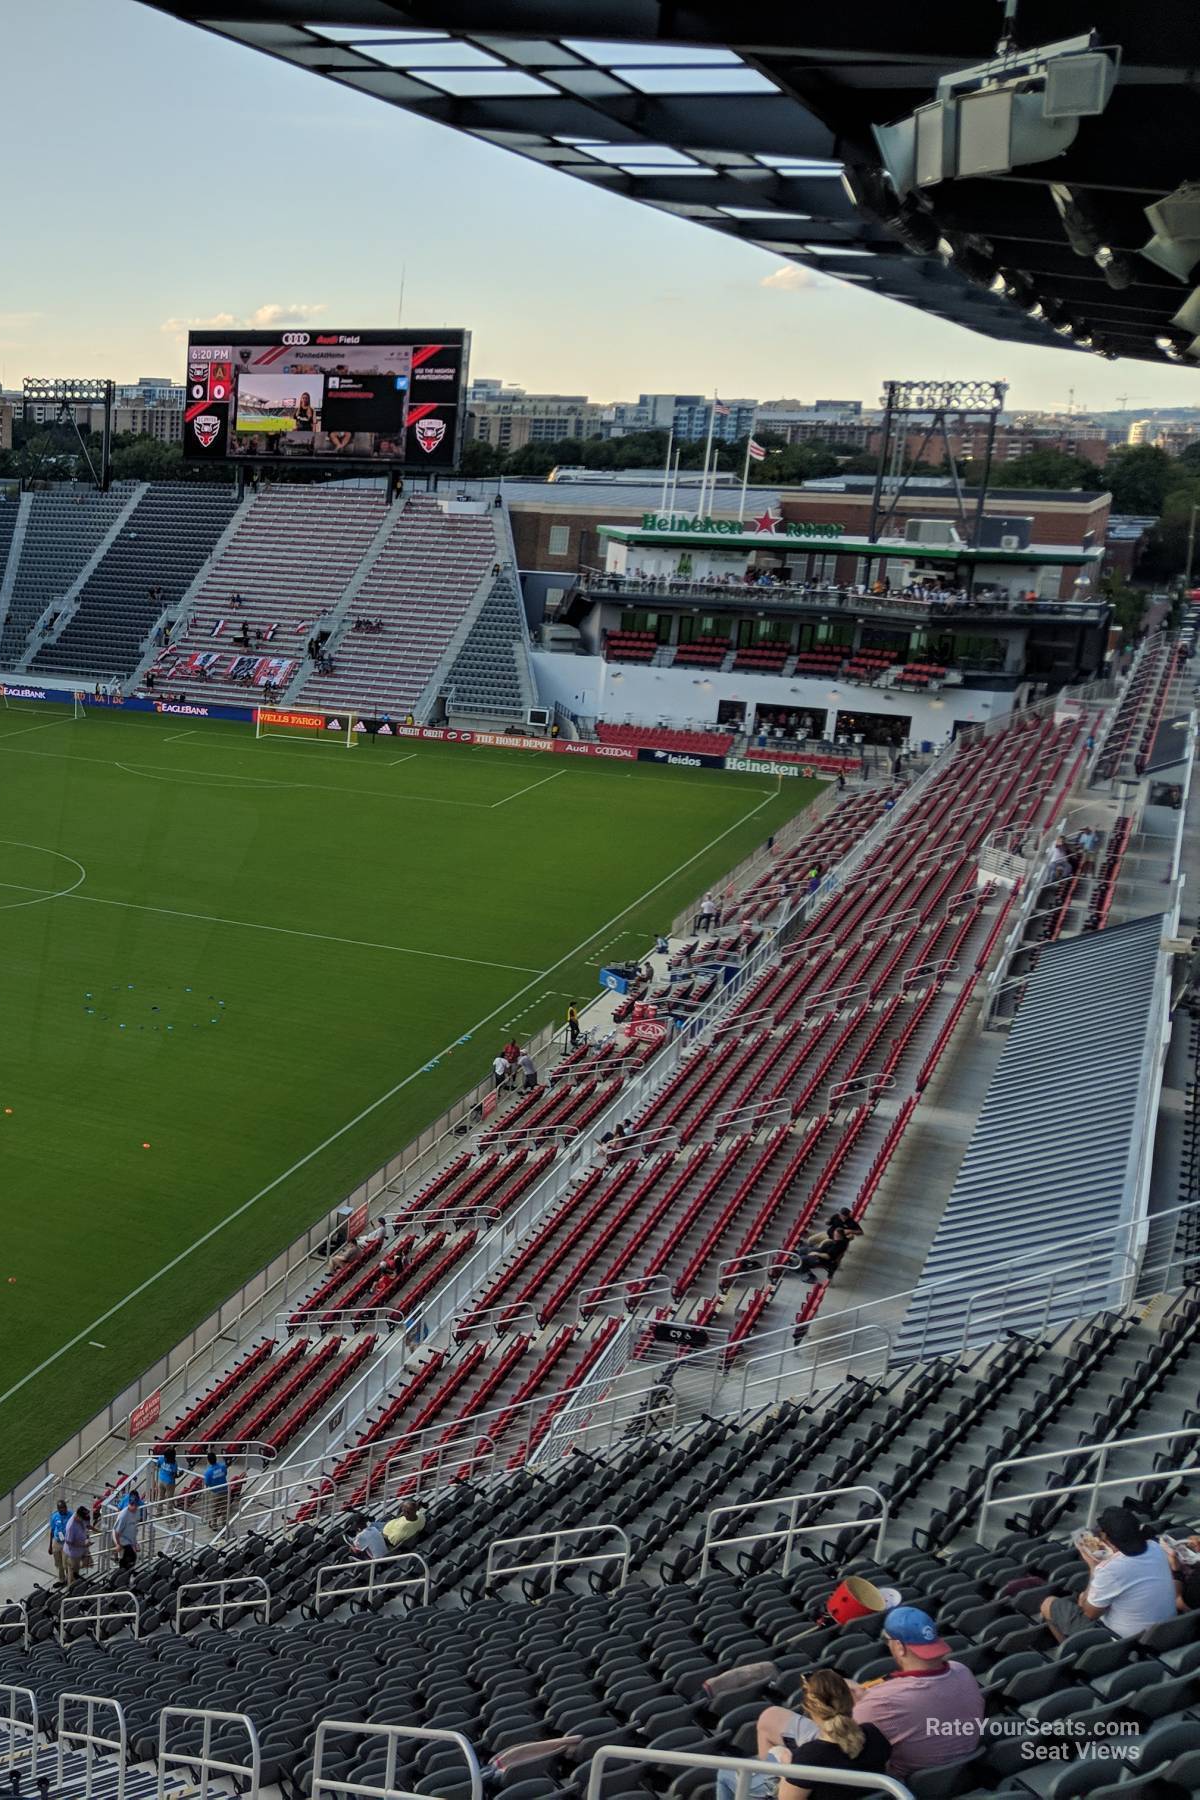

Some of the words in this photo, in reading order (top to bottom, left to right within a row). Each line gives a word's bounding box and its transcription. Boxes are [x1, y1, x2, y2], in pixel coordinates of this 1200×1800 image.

[338, 335, 360, 344] Field
[191, 350, 212, 360] 6:20
[214, 350, 229, 360] PM
[192, 384, 204, 399] 0
[213, 384, 225, 399] 0
[641, 512, 745, 535] Heineken
[161, 703, 209, 716] EAGLEBANK
[259, 713, 289, 724] WELLS
[290, 715, 322, 727] FARGO
[475, 734, 494, 744] THE
[495, 736, 521, 747] HOME
[522, 738, 554, 750] DEPOT
[565, 743, 588, 753] Audi
[667, 753, 701, 767] leidos
[724, 757, 799, 777] Heineken
[669, 1329, 682, 1339] C9
